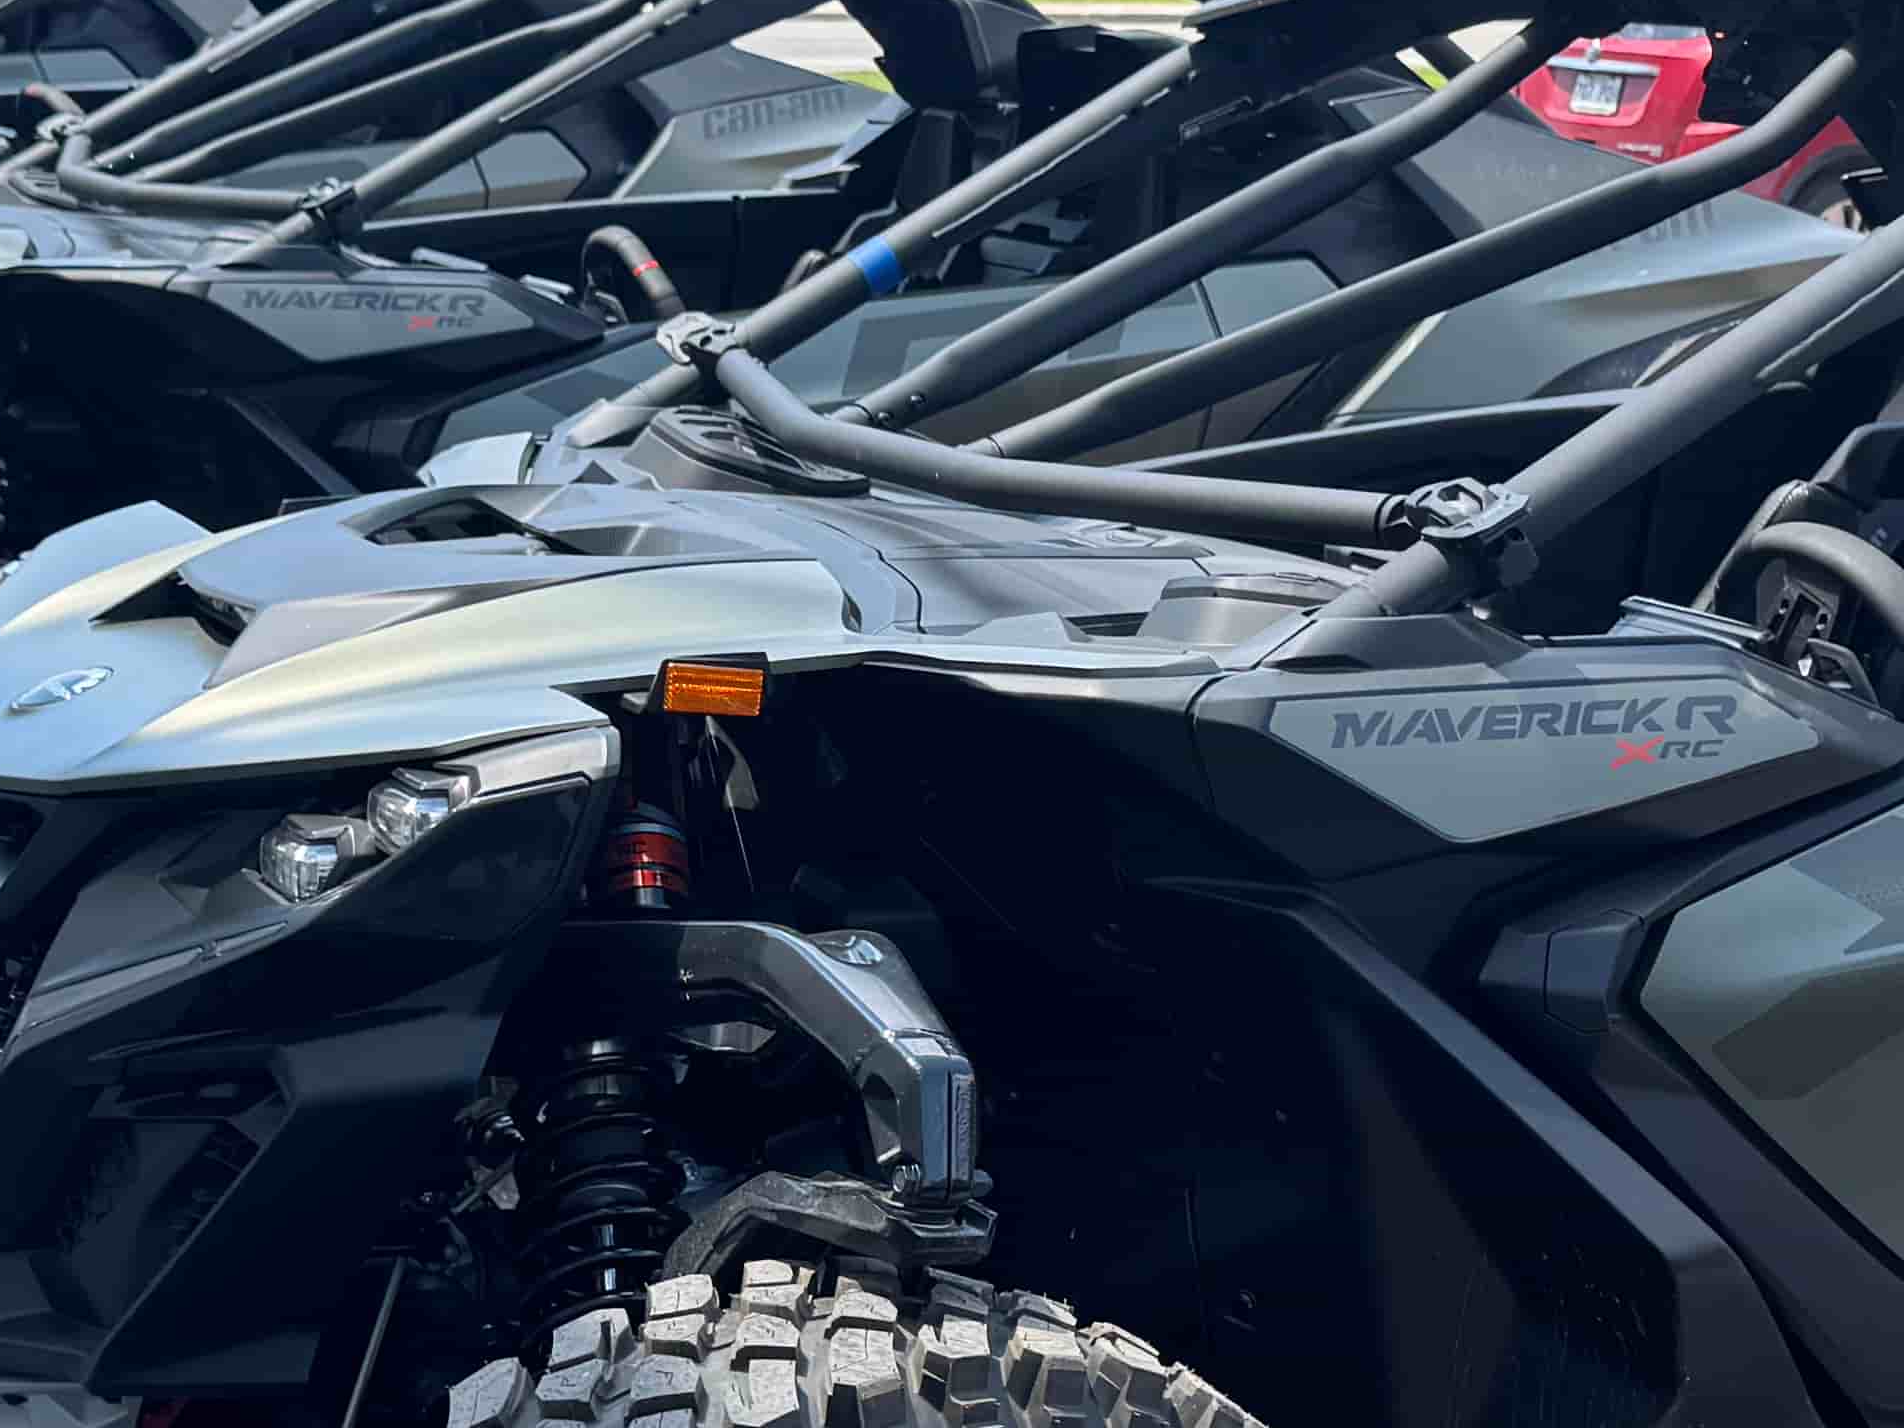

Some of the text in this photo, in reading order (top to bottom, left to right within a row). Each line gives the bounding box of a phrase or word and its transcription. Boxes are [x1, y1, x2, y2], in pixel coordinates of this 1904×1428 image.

[702, 85, 848, 140] can-am
[242, 290, 486, 317] MAVERICK R
[1330, 694, 1738, 750] MAVERICK R
